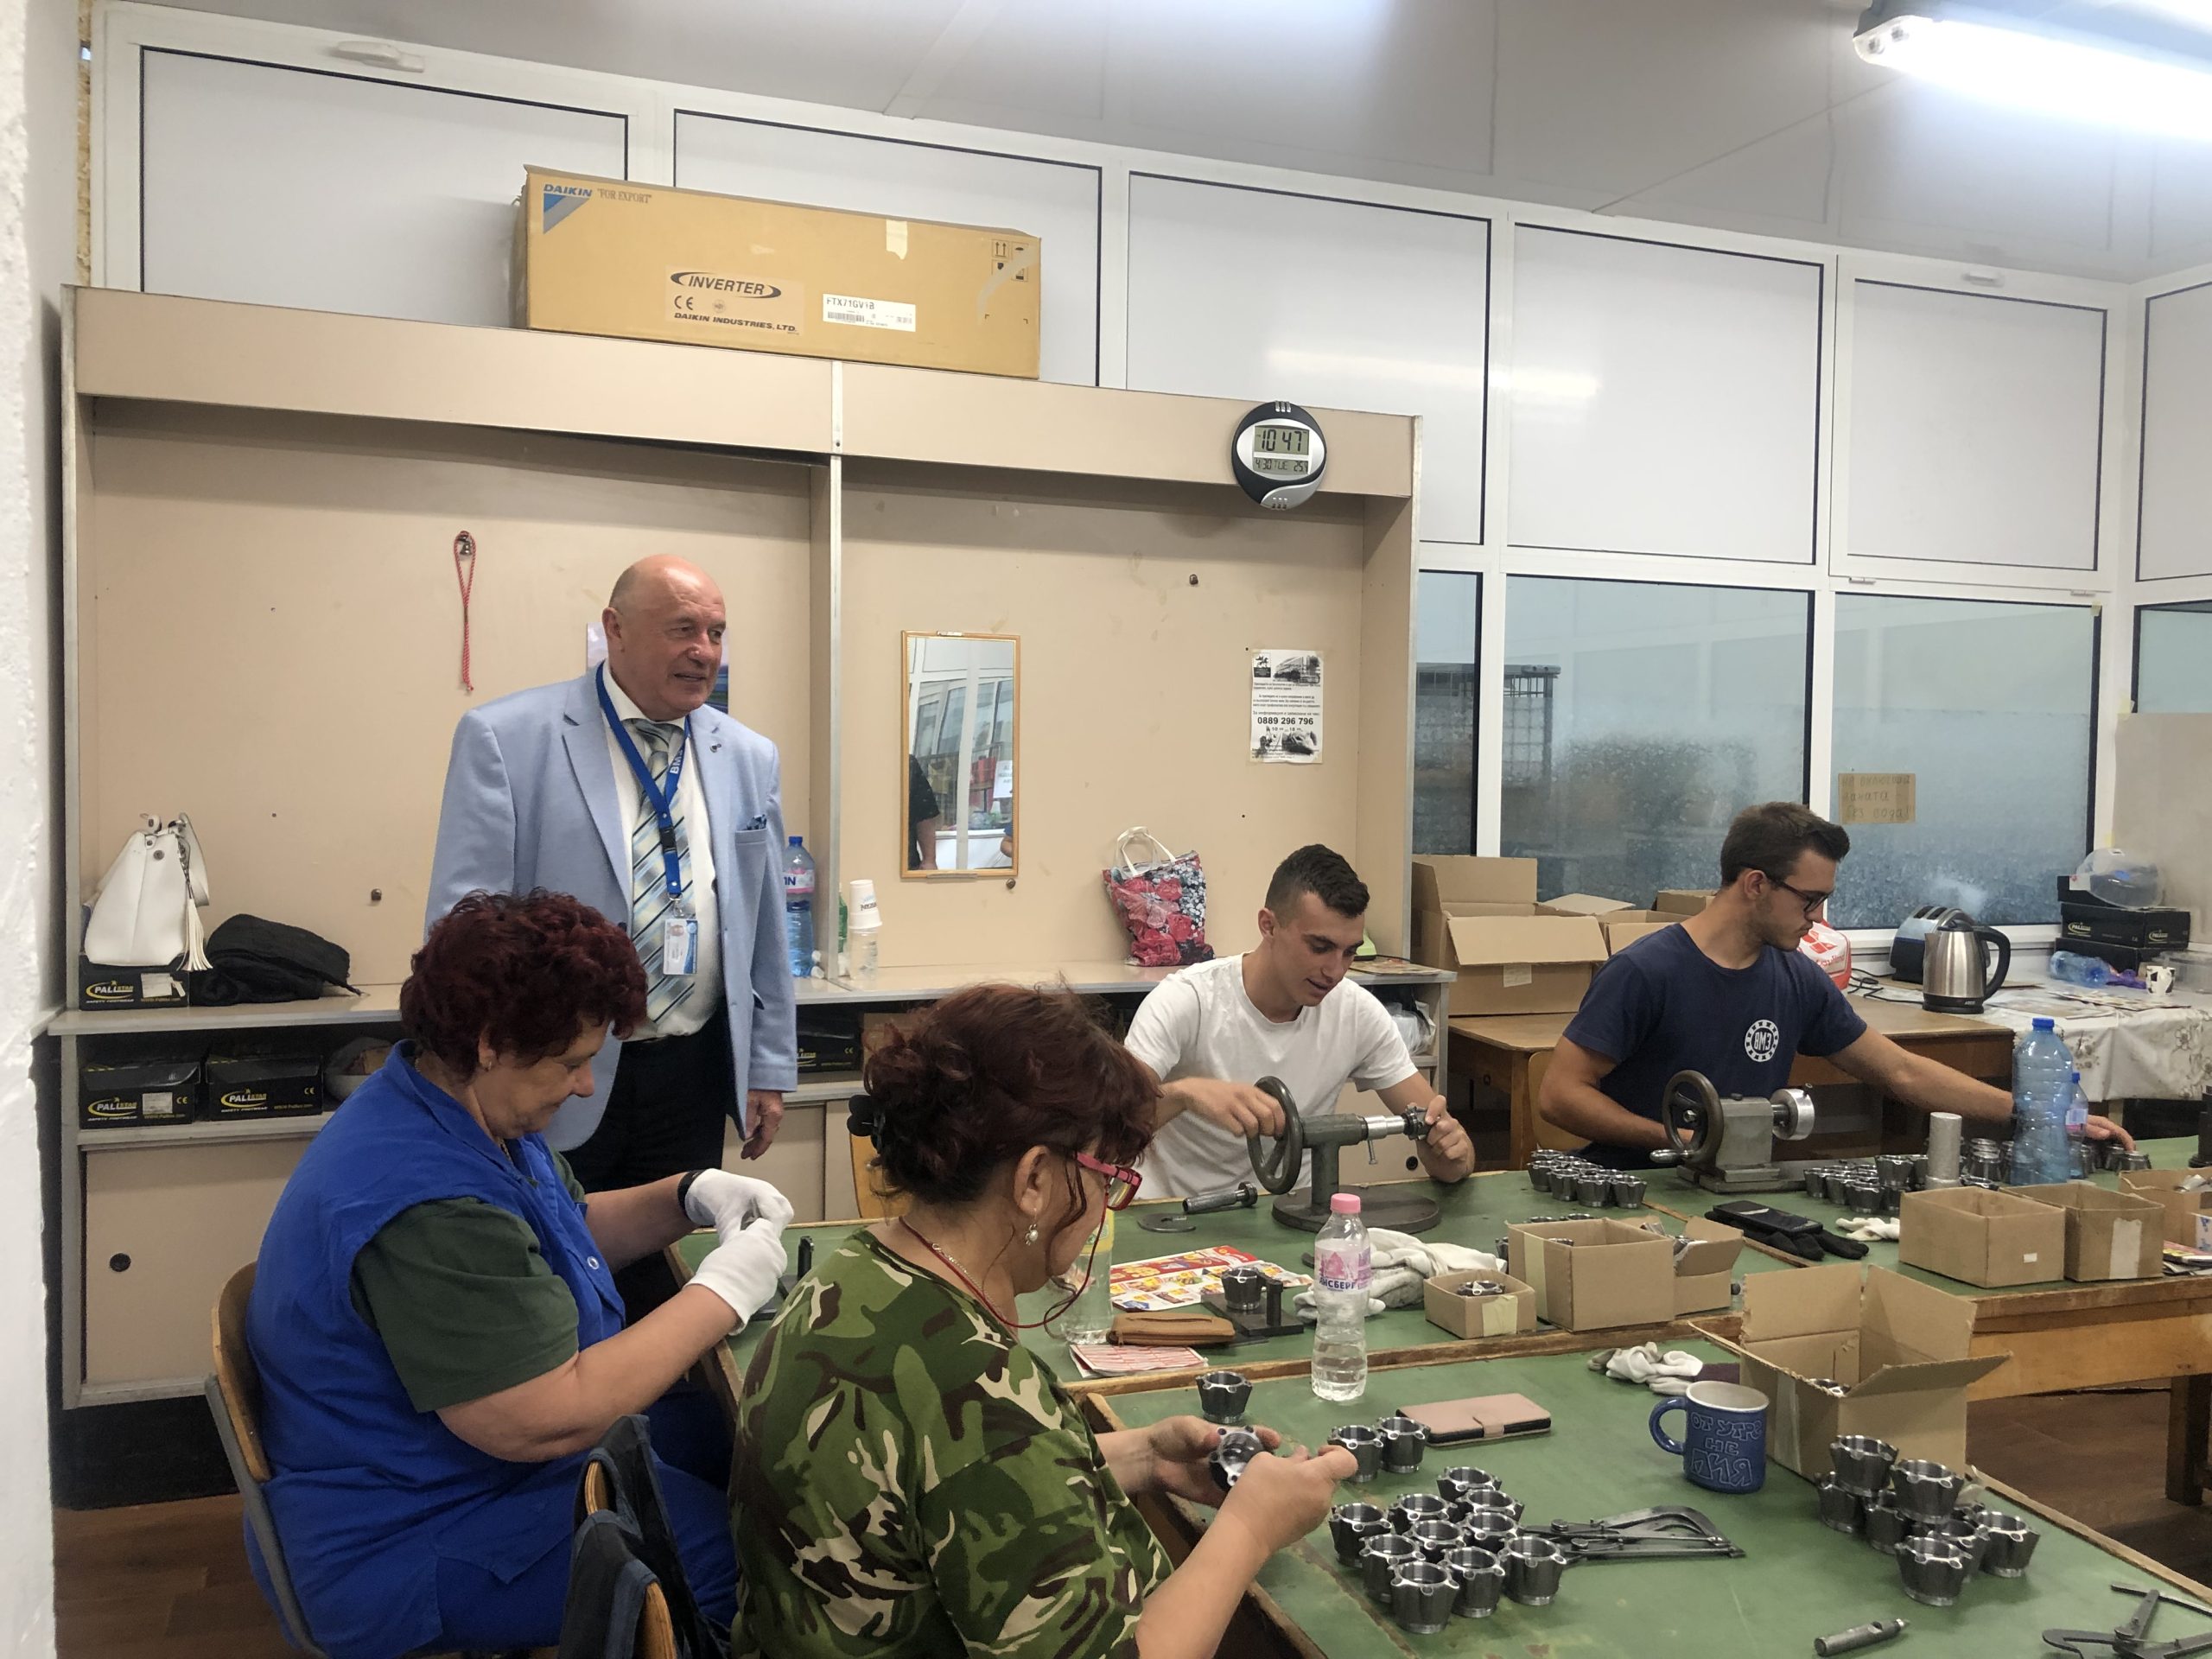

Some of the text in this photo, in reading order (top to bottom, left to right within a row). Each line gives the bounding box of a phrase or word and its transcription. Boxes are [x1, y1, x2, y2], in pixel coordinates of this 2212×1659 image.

[543, 183, 593, 197] DAIKIN
[688, 275, 766, 296] INVERTER
[674, 312, 710, 322] DAIKIN
[712, 316, 775, 330] INDUSTRIES,
[1257, 716, 1279, 725] 0889
[1281, 716, 1296, 725] 296
[1690, 1411, 1713, 1432] ОТ
[1705, 1437, 1739, 1456] НЕ
